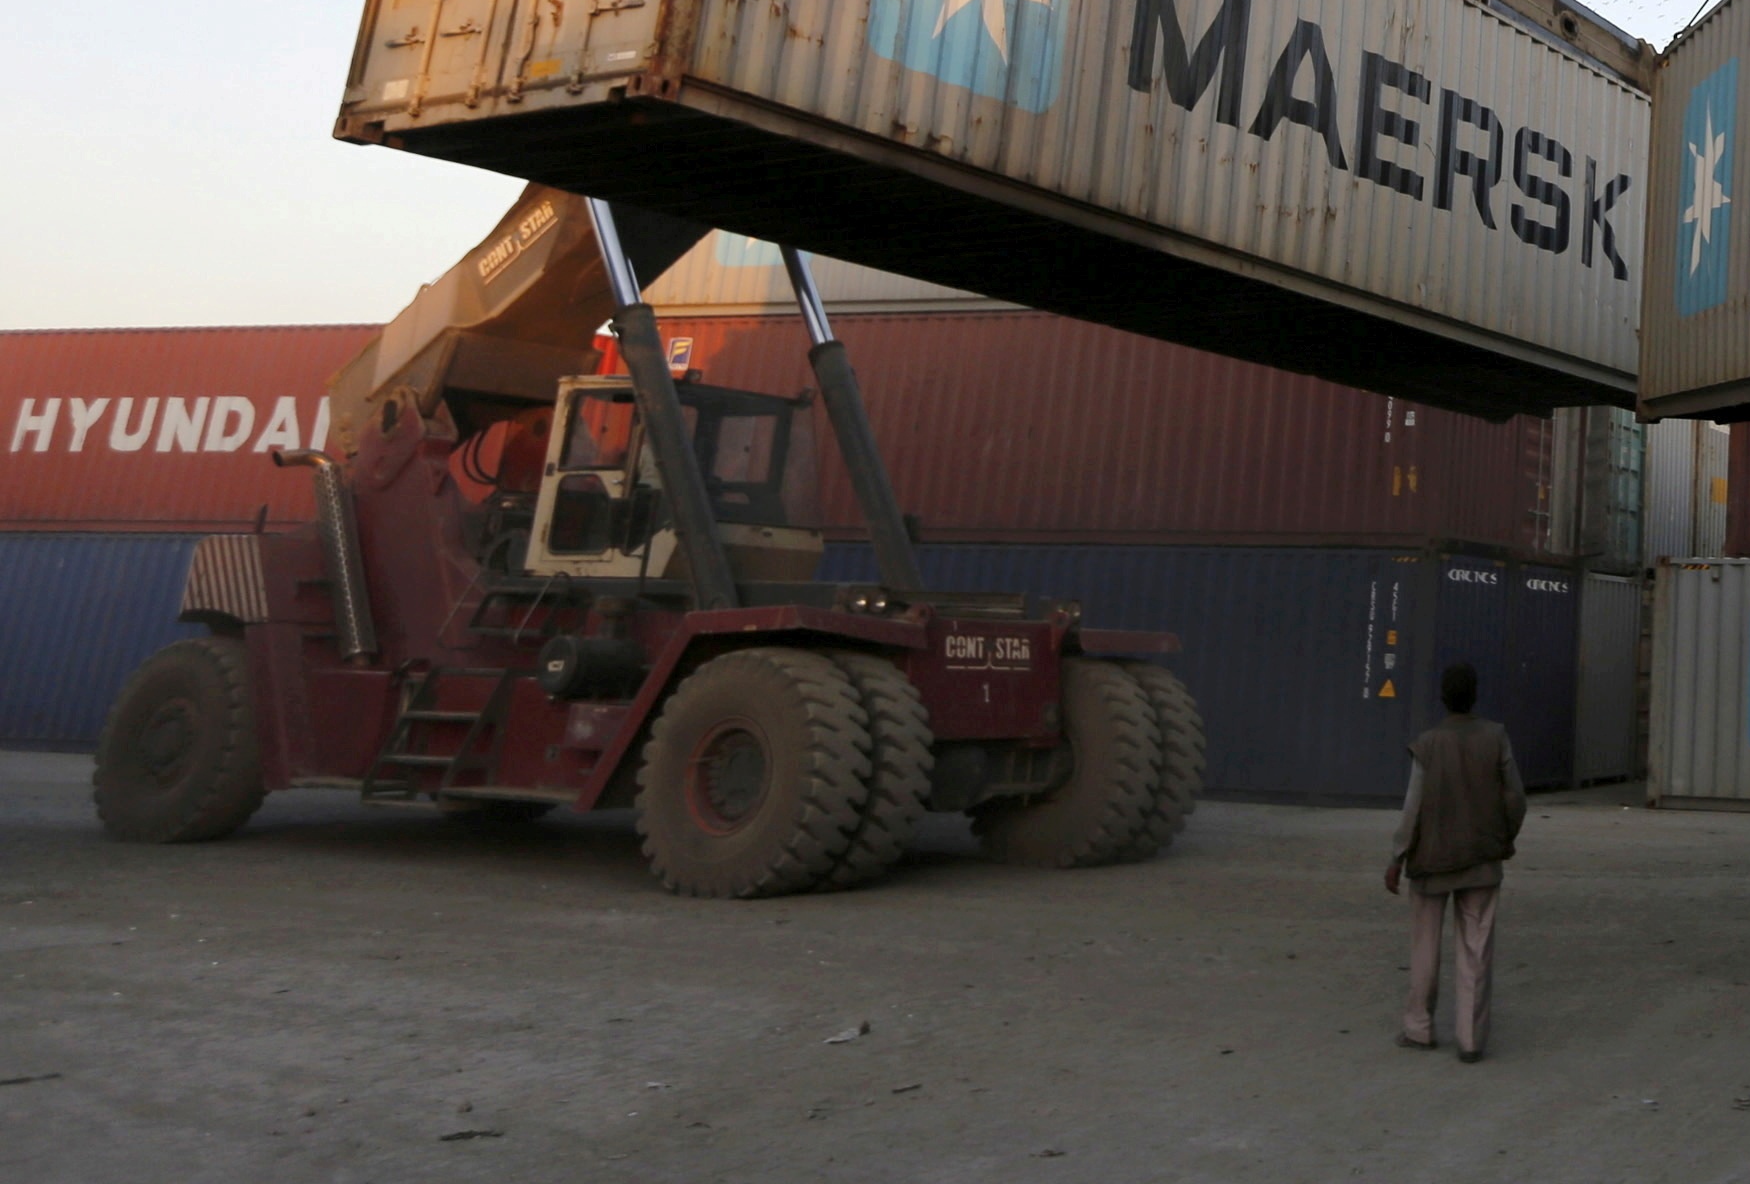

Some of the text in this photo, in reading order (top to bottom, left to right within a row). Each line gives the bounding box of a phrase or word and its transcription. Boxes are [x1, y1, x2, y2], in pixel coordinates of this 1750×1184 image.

[10, 395, 331, 454] HYUNDAI
[946, 635, 1031, 660] CONT STAR
